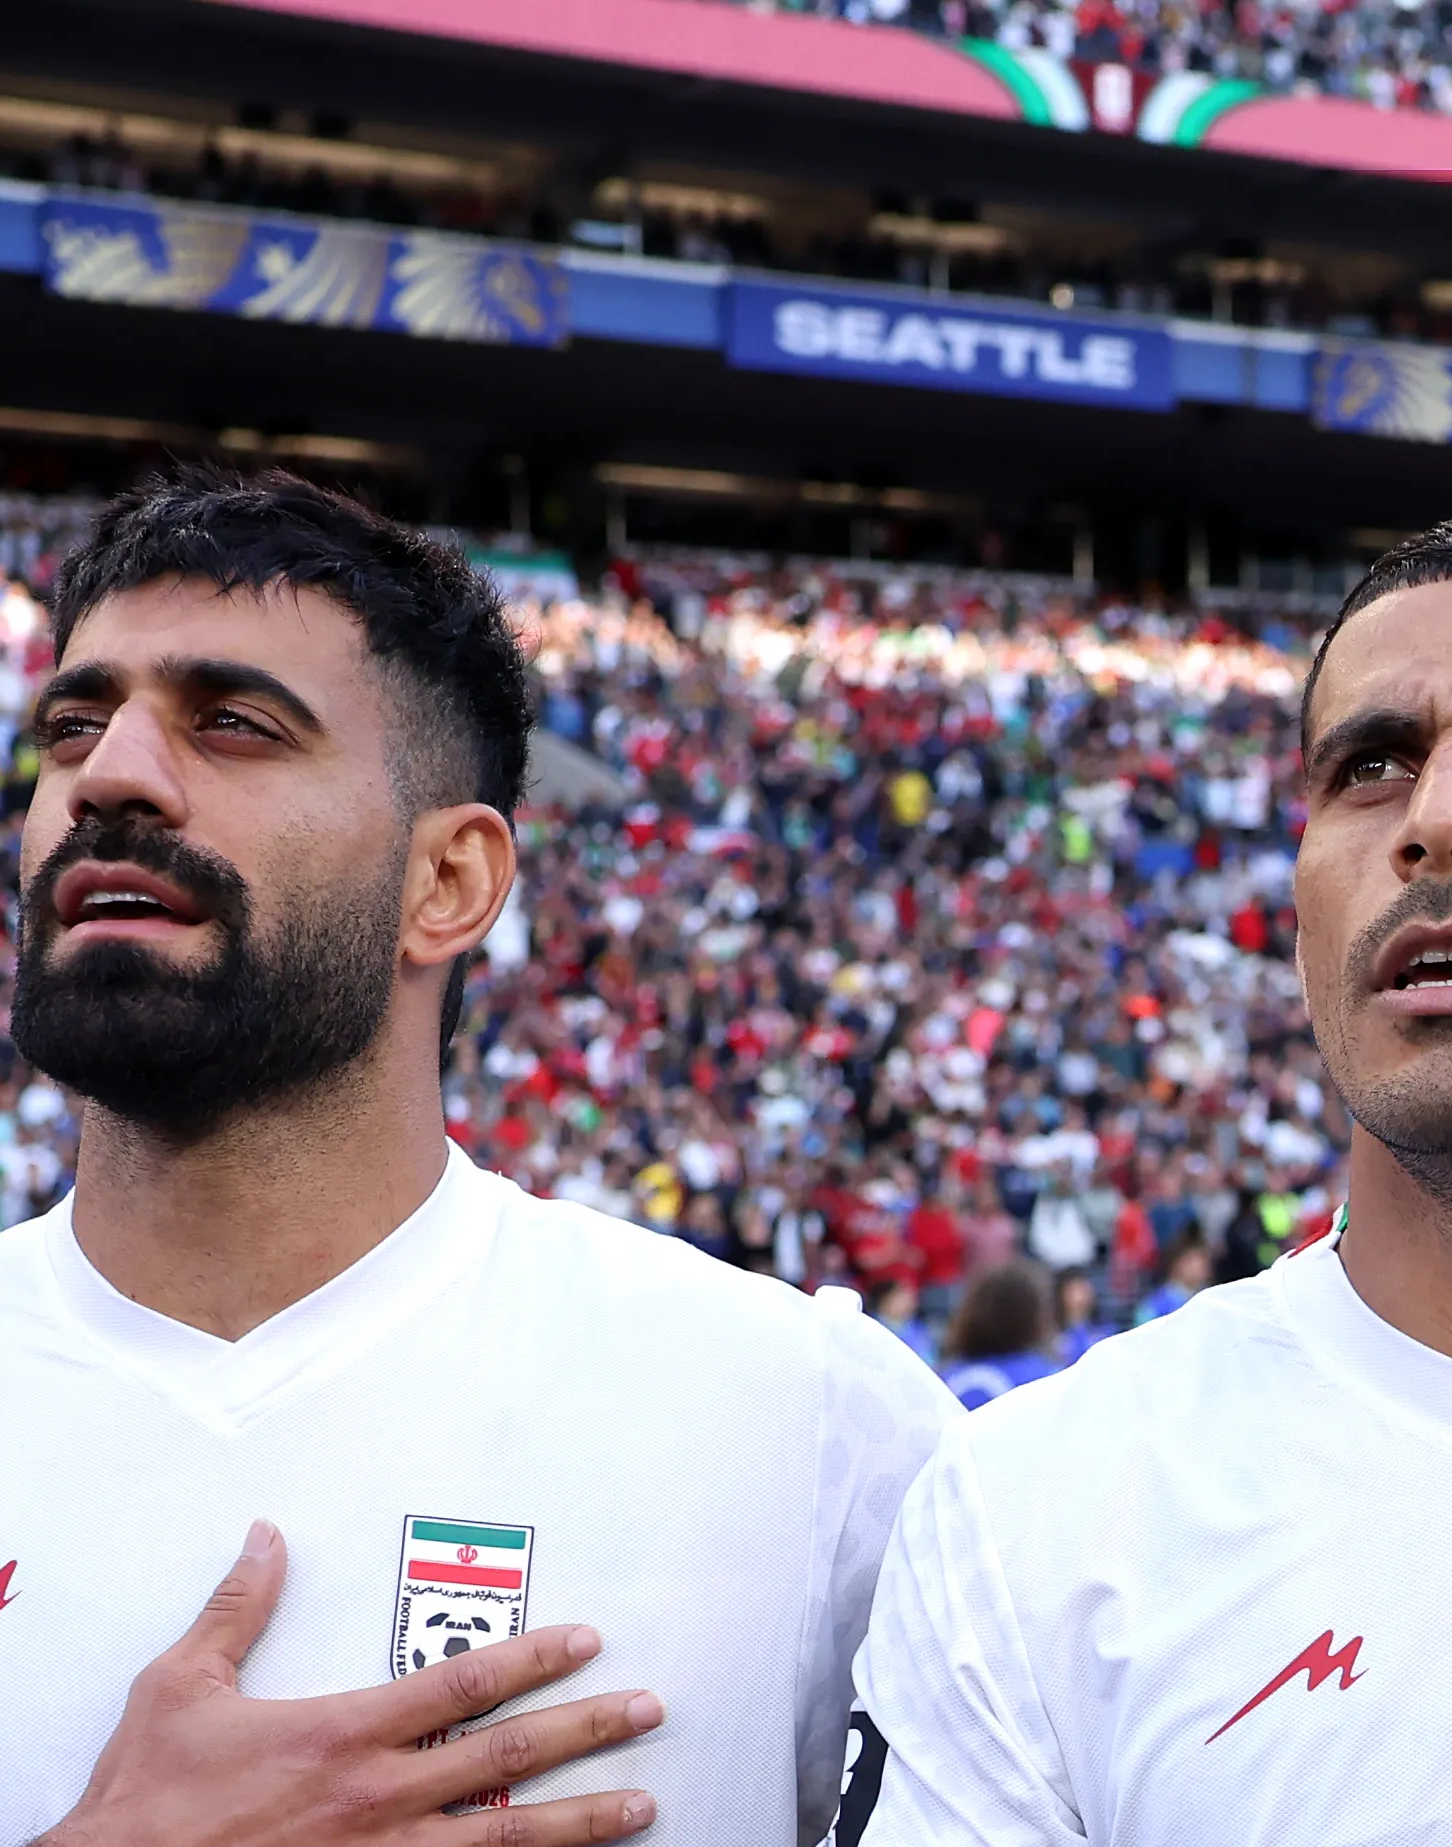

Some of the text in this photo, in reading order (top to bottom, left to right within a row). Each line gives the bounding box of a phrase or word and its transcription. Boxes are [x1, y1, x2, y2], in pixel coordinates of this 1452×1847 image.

[775, 300, 1136, 389] SEATTLE
[397, 1596, 411, 1652] FOOTBALL
[445, 1621, 472, 1631] IRAN
[509, 1607, 520, 1637] IRAN
